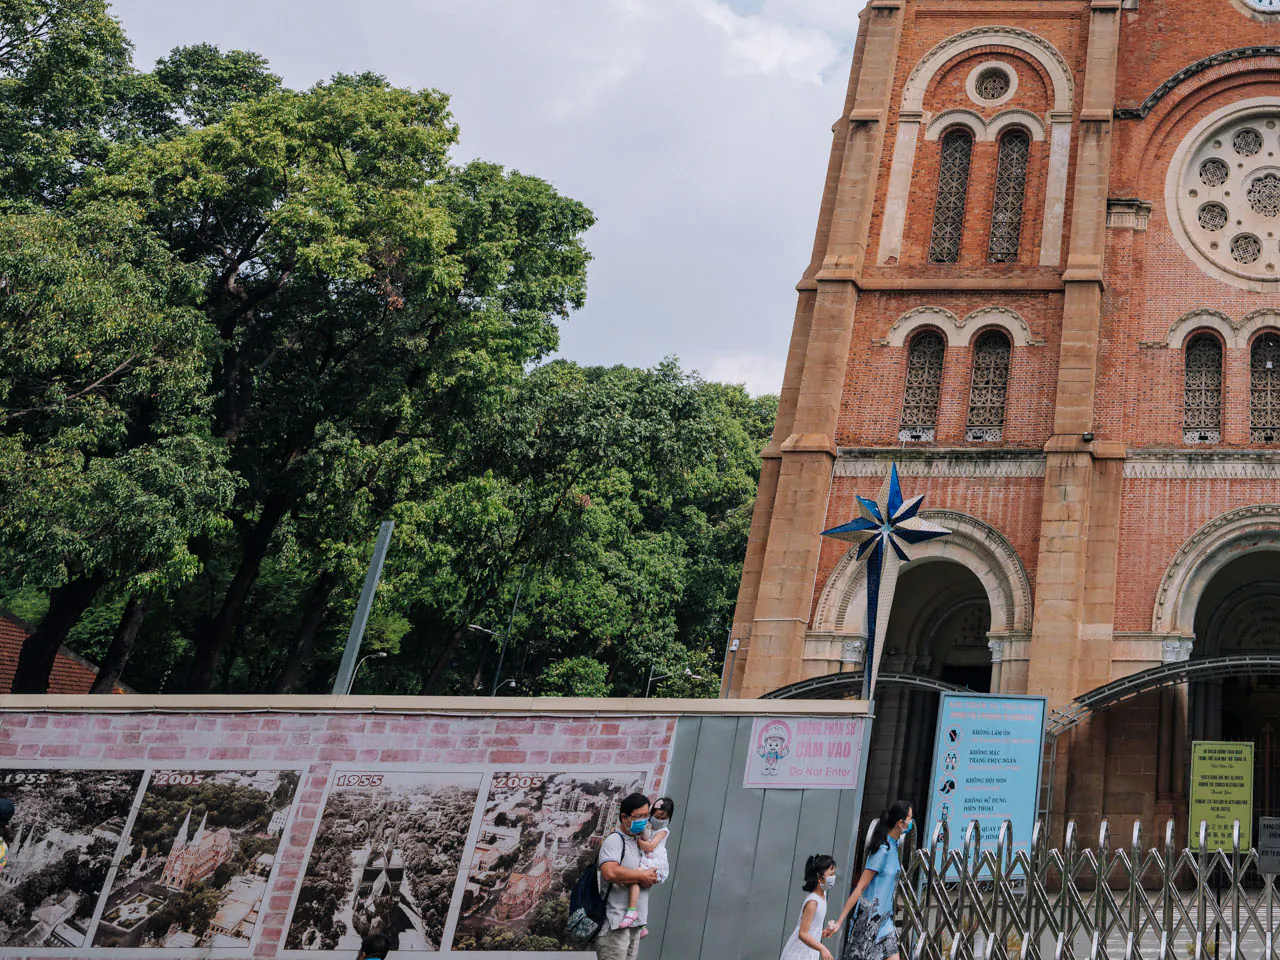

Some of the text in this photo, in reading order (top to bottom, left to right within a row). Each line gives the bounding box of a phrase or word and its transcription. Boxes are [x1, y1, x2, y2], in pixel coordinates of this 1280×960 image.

[828, 740, 851, 758] VÀO
[790, 766, 850, 777] Do Not Enter
[4, 774, 49, 784] 1955
[156, 774, 205, 786] 2005
[337, 774, 384, 786] 1955
[495, 776, 544, 788] 2005
